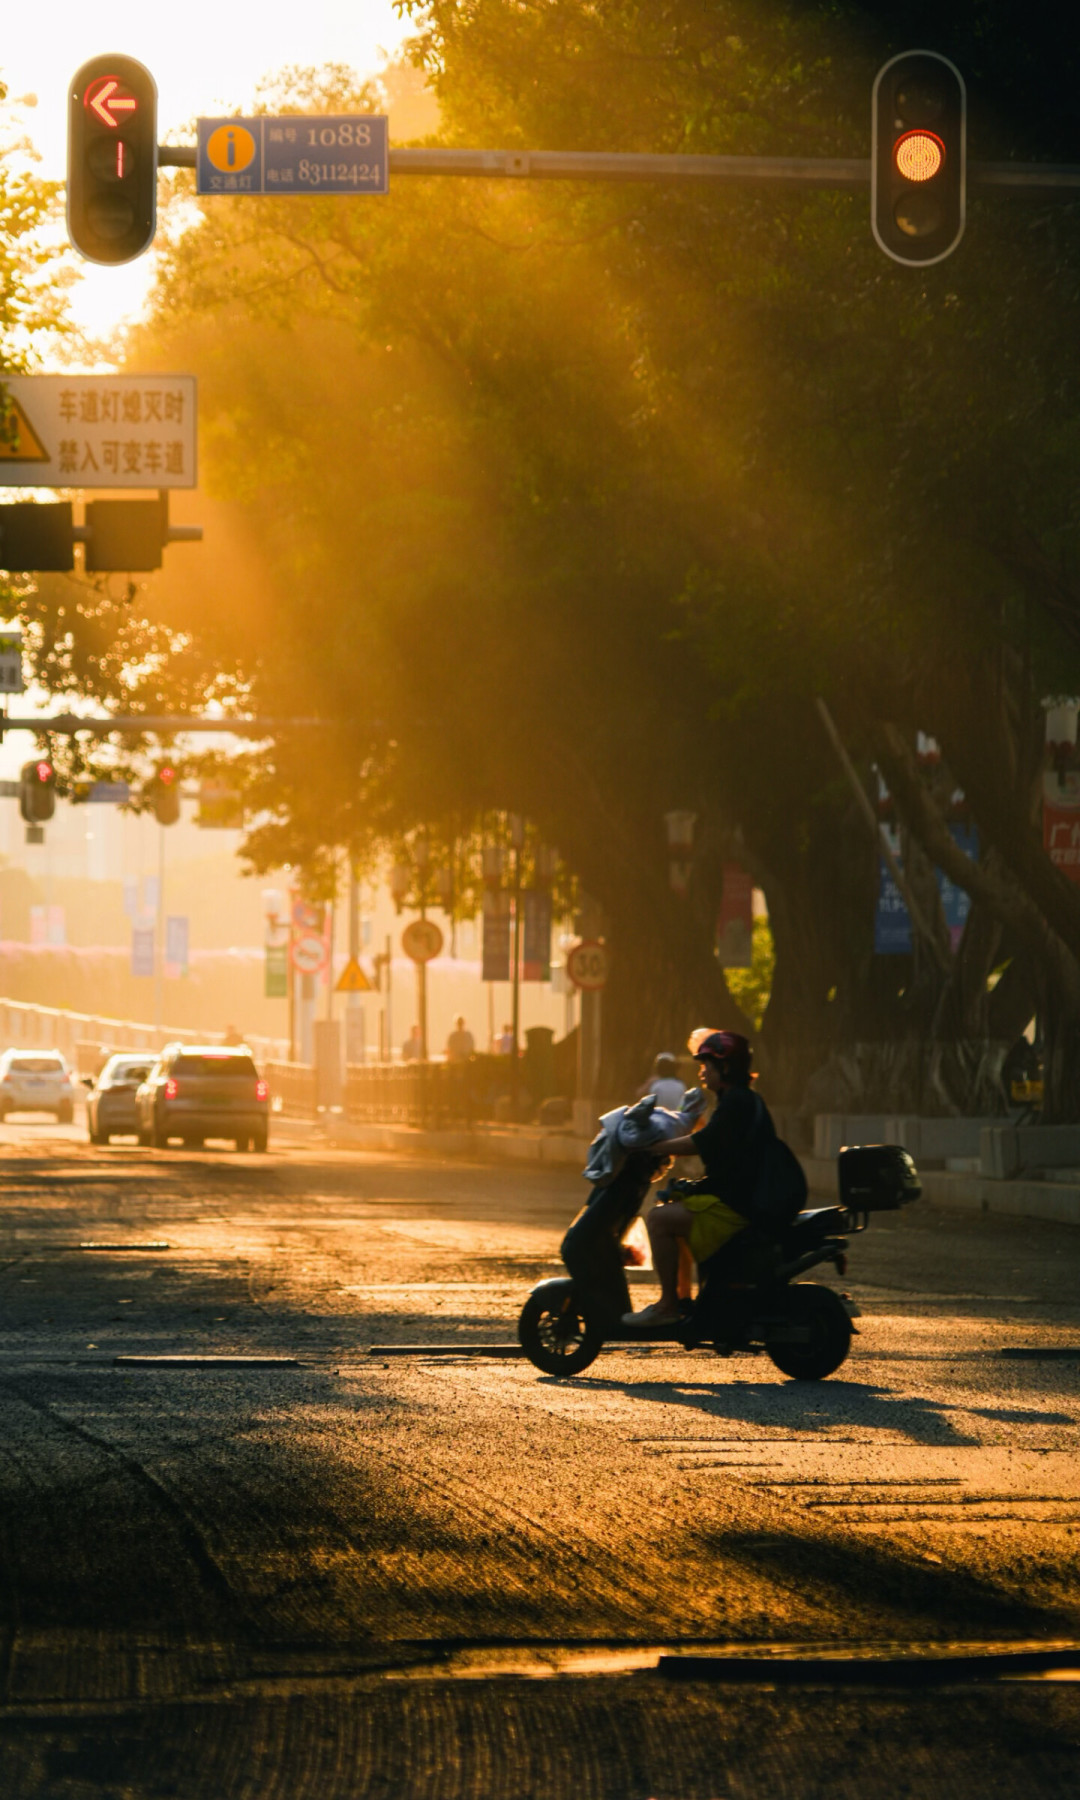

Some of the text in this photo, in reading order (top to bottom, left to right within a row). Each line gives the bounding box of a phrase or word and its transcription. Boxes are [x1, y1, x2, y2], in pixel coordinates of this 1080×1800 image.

[307, 123, 371, 146] 1088
[208, 175, 253, 190] 交通灯
[267, 159, 380, 186] 电话 83112424
[58, 389, 184, 425] 车道灯熄灭时
[58, 439, 184, 475] 禁入可变车道
[576, 953, 600, 977] 30
